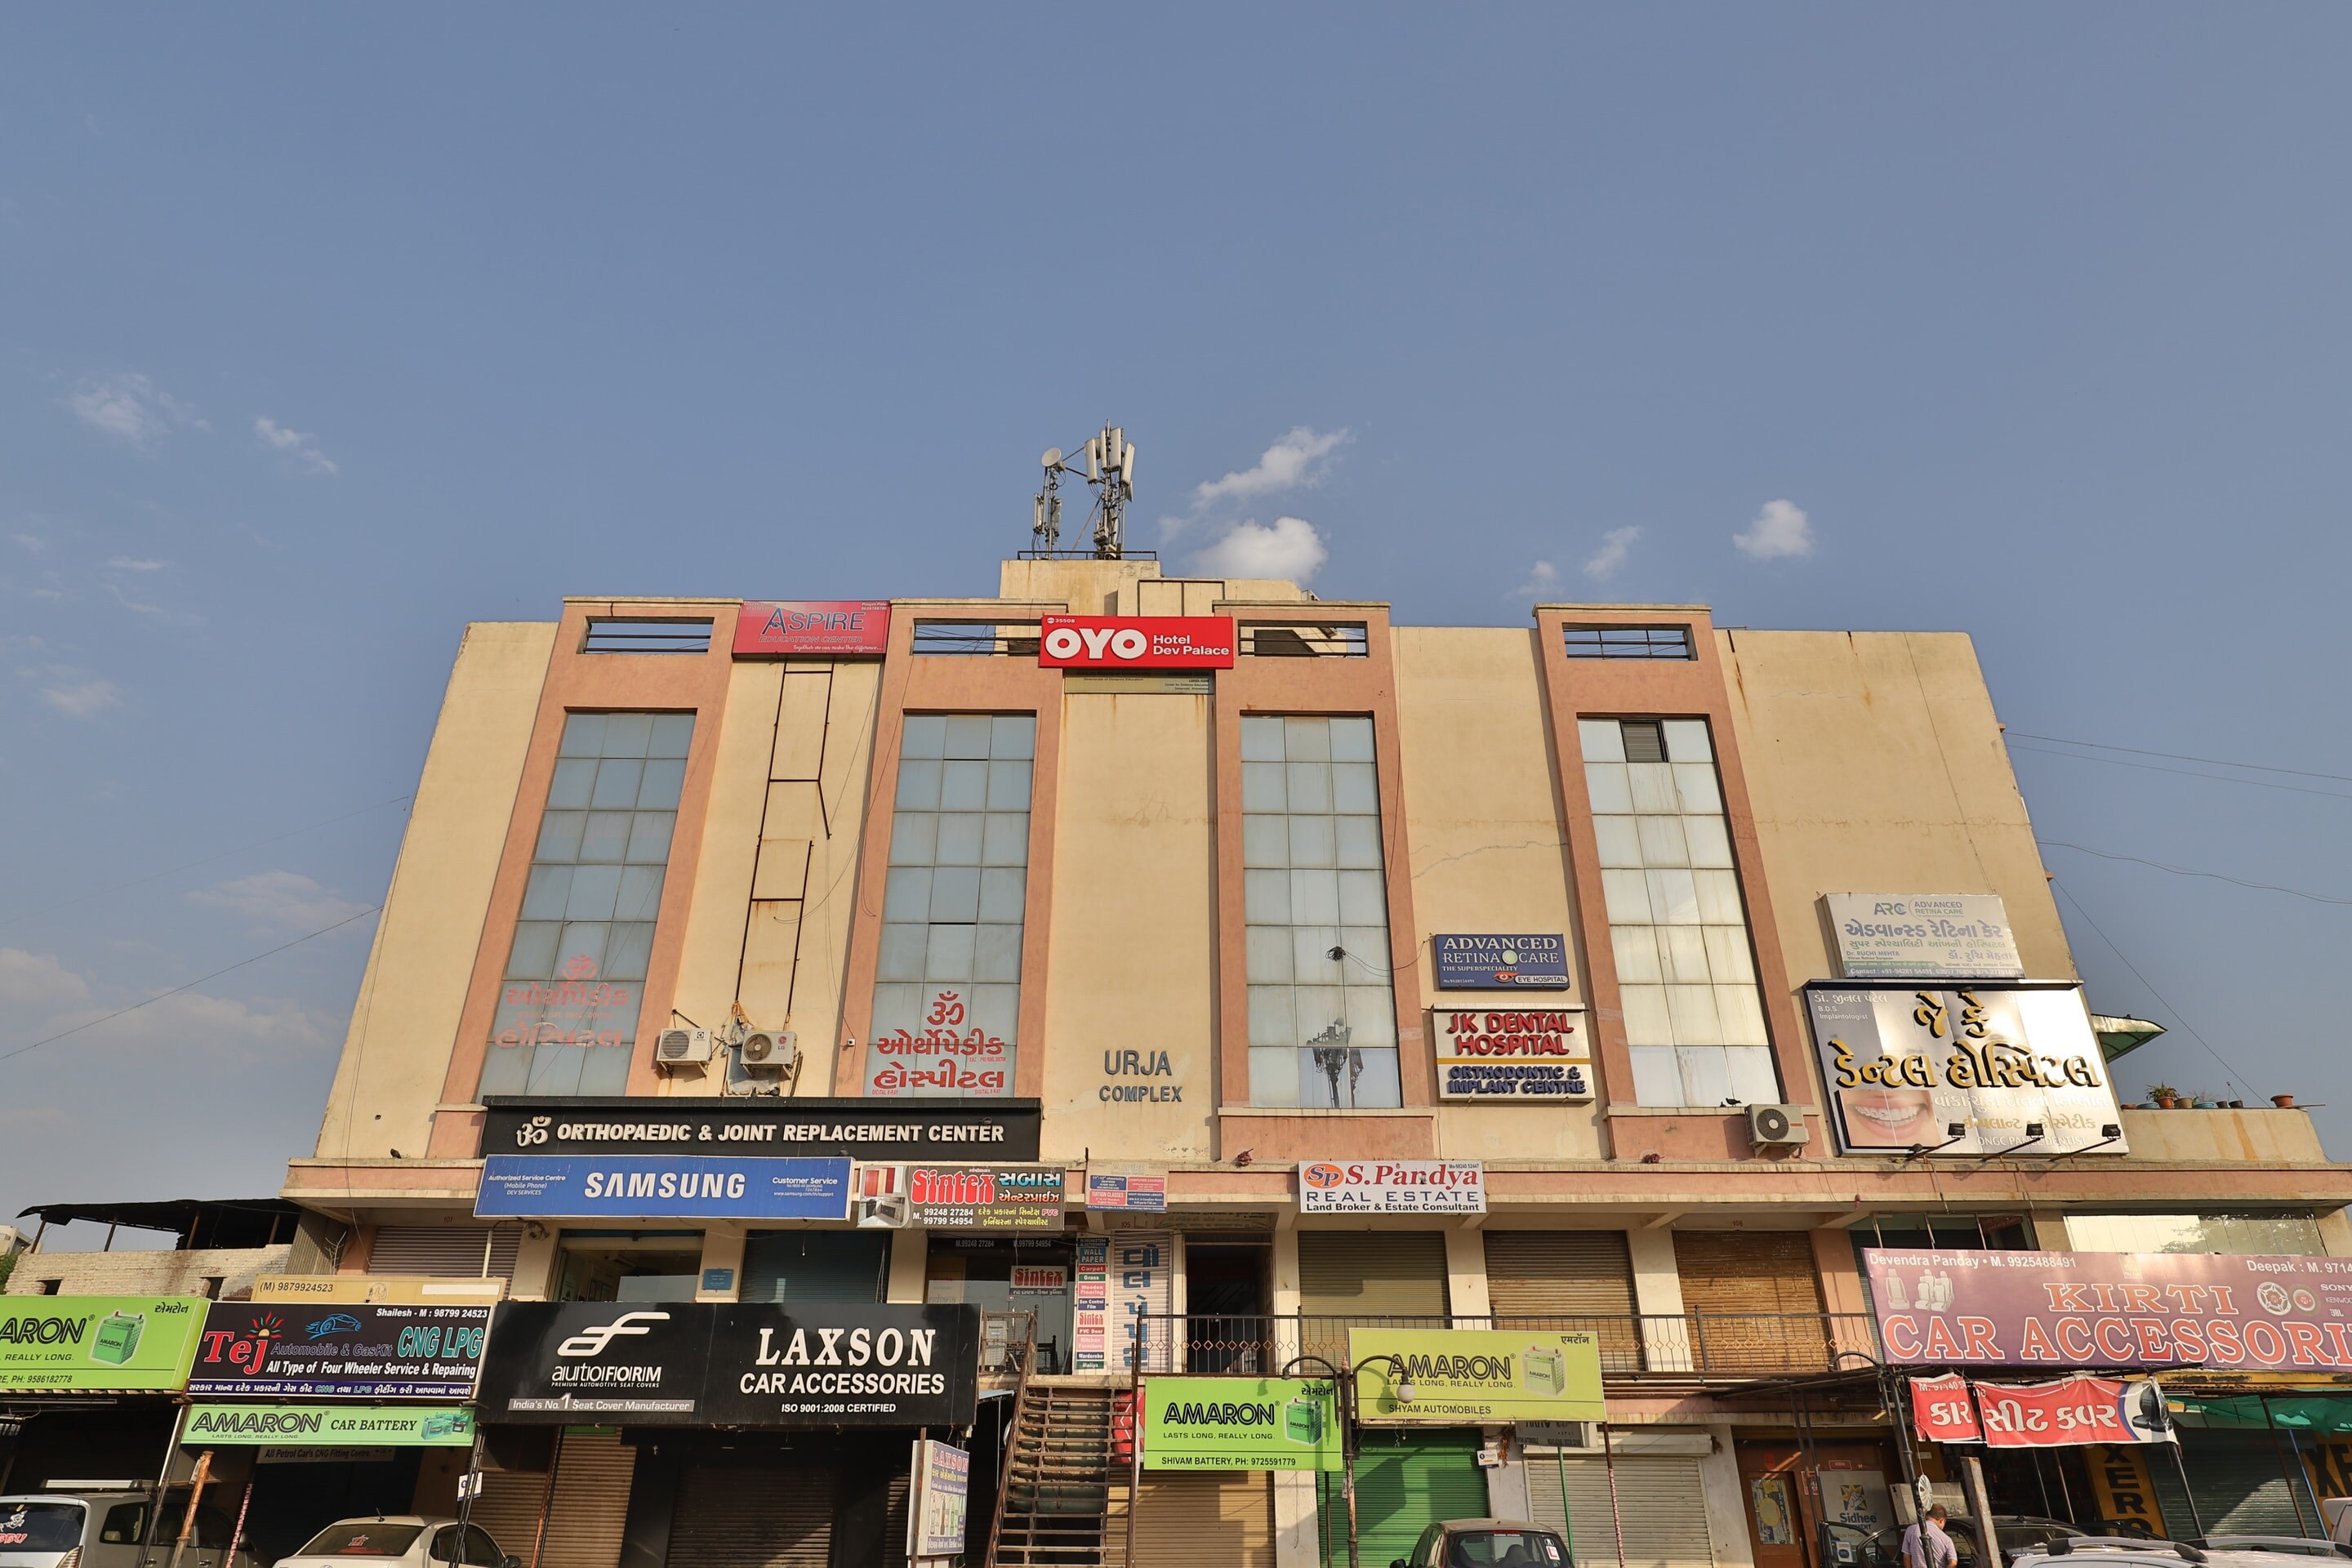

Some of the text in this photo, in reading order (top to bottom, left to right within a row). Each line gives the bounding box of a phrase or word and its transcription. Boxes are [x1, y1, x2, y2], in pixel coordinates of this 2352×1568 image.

[761, 608, 866, 635] ASPIRE
[1045, 627, 1147, 660] OYO
[1152, 635, 1191, 644] Hotel
[1152, 645, 1229, 655] Dev Palace
[1443, 938, 1558, 950] ADVANCED
[1443, 952, 1559, 964] RETINA CARE
[1446, 1013, 1575, 1034] JK DENTAL
[1454, 1034, 1570, 1056] HOSPITAL
[1104, 1049, 1172, 1076] URJA
[1449, 1066, 1565, 1080] ORTHODONTIC
[1099, 1085, 1183, 1102] COMPLEX
[1446, 1080, 1586, 1094] IMPLANT CENTRE
[557, 1123, 1004, 1143] ORTHOPAEDIC JOINT REPLACEMENT CENTER
[1977, 1136, 2007, 1146] ONGC
[585, 1172, 746, 1199] SAMSUNG
[911, 1169, 996, 1205] Sintex
[1307, 1192, 1478, 1202] REAL ESTATE
[924, 1208, 973, 1216] 99248 27284
[1307, 1203, 1332, 1211] Land
[1335, 1203, 1370, 1211] Broker
[1422, 1203, 1480, 1211] Consultant
[924, 1217, 973, 1225] 99799 54954
[1869, 1253, 2077, 1269] Devendra Panday 9925488491
[2246, 1260, 2296, 1274] Deepak
[1014, 1267, 1062, 1286] Sintex
[260, 1281, 334, 1294] (M) 9879924523
[2320, 1283, 2352, 1291] SONY
[2042, 1282, 2239, 1315] KIRTI
[154, 1302, 189, 1314] એમરોન
[376, 1308, 488, 1319] Shailesh 98799 24523
[1079, 1312, 1103, 1325] Sintex
[397, 1325, 483, 1360] CNG LPG
[755, 1327, 936, 1367] LAXSON
[1882, 1314, 2352, 1366] CAR ACCESSORI
[203, 1331, 269, 1375] Tej
[270, 1342, 338, 1356] Automobile
[5, 1353, 42, 1361] REALLY
[266, 1360, 476, 1379] All Type of Four Wheeler Service Repairing
[1387, 1353, 1512, 1380] AMARON
[26, 1374, 74, 1384] 9586182778
[740, 1373, 945, 1395] CAR ACCESSORIES
[1488, 1380, 1516, 1388] LONG.
[314, 1384, 335, 1393] CNG
[353, 1384, 372, 1393] LPG
[512, 1399, 689, 1411] India's No. Seat Cover Manufacturer
[782, 1404, 897, 1413] ISO 9001:2008 CERTIFIED
[1388, 1404, 1491, 1414] SHYAM AUTOMOBILES
[1163, 1402, 1275, 1425] AMARON
[1930, 1399, 2118, 1432] કાર સીટ કવર
[191, 1411, 417, 1433] AMARON CAR BATTERY
[933, 1447, 969, 1472] LAXSON
[1161, 1456, 1296, 1466] SHIVAM BATTERY, PH: 9725591779
[1839, 1512, 1877, 1523] Sidhee
